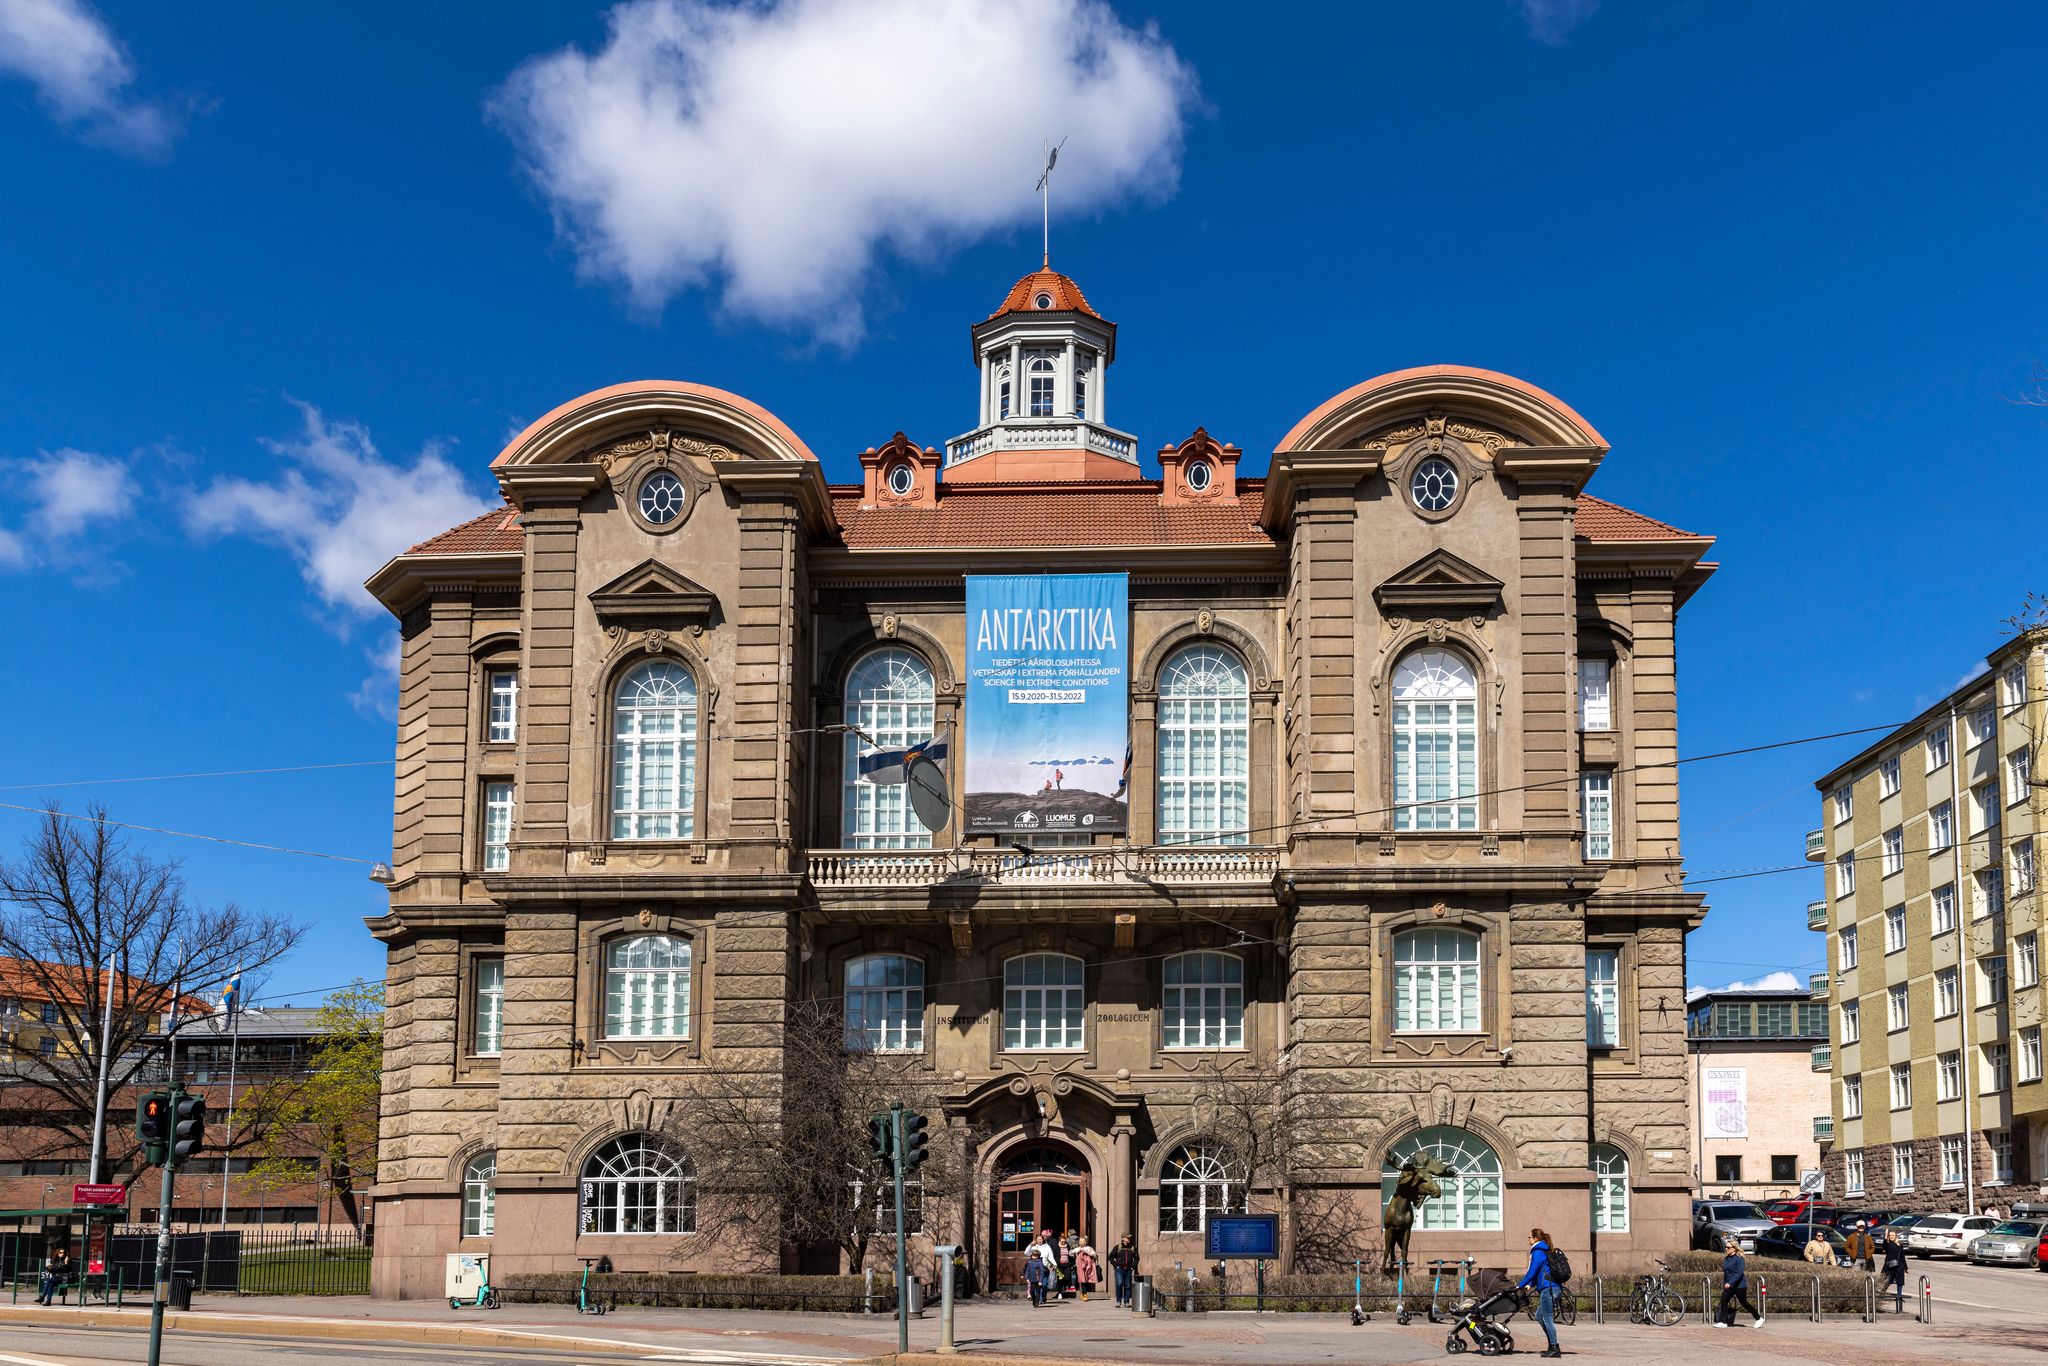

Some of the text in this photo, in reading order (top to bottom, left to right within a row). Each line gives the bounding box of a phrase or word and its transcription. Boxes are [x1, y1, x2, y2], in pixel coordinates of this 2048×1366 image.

[977, 608, 1117, 651] ANTARKTIKA
[992, 658, 1101, 667] TIEDETTÄ ÄÄRIOLOSUHTEISSA
[973, 669, 1017, 677] VETENSKAP
[1022, 669, 1057, 677] EXTREMA
[1059, 667, 1120, 677] FÖRHÅLLANDEN
[984, 679, 1015, 687] SCIENCE
[1062, 678, 1109, 686] CONDITIONS
[1045, 814, 1076, 822] LUOMUS
[937, 1016, 989, 1025] INSTITUTUM
[1097, 1014, 1150, 1022] ZOOLOGICUM
[1212, 1221, 1220, 1252] LUOMUS
